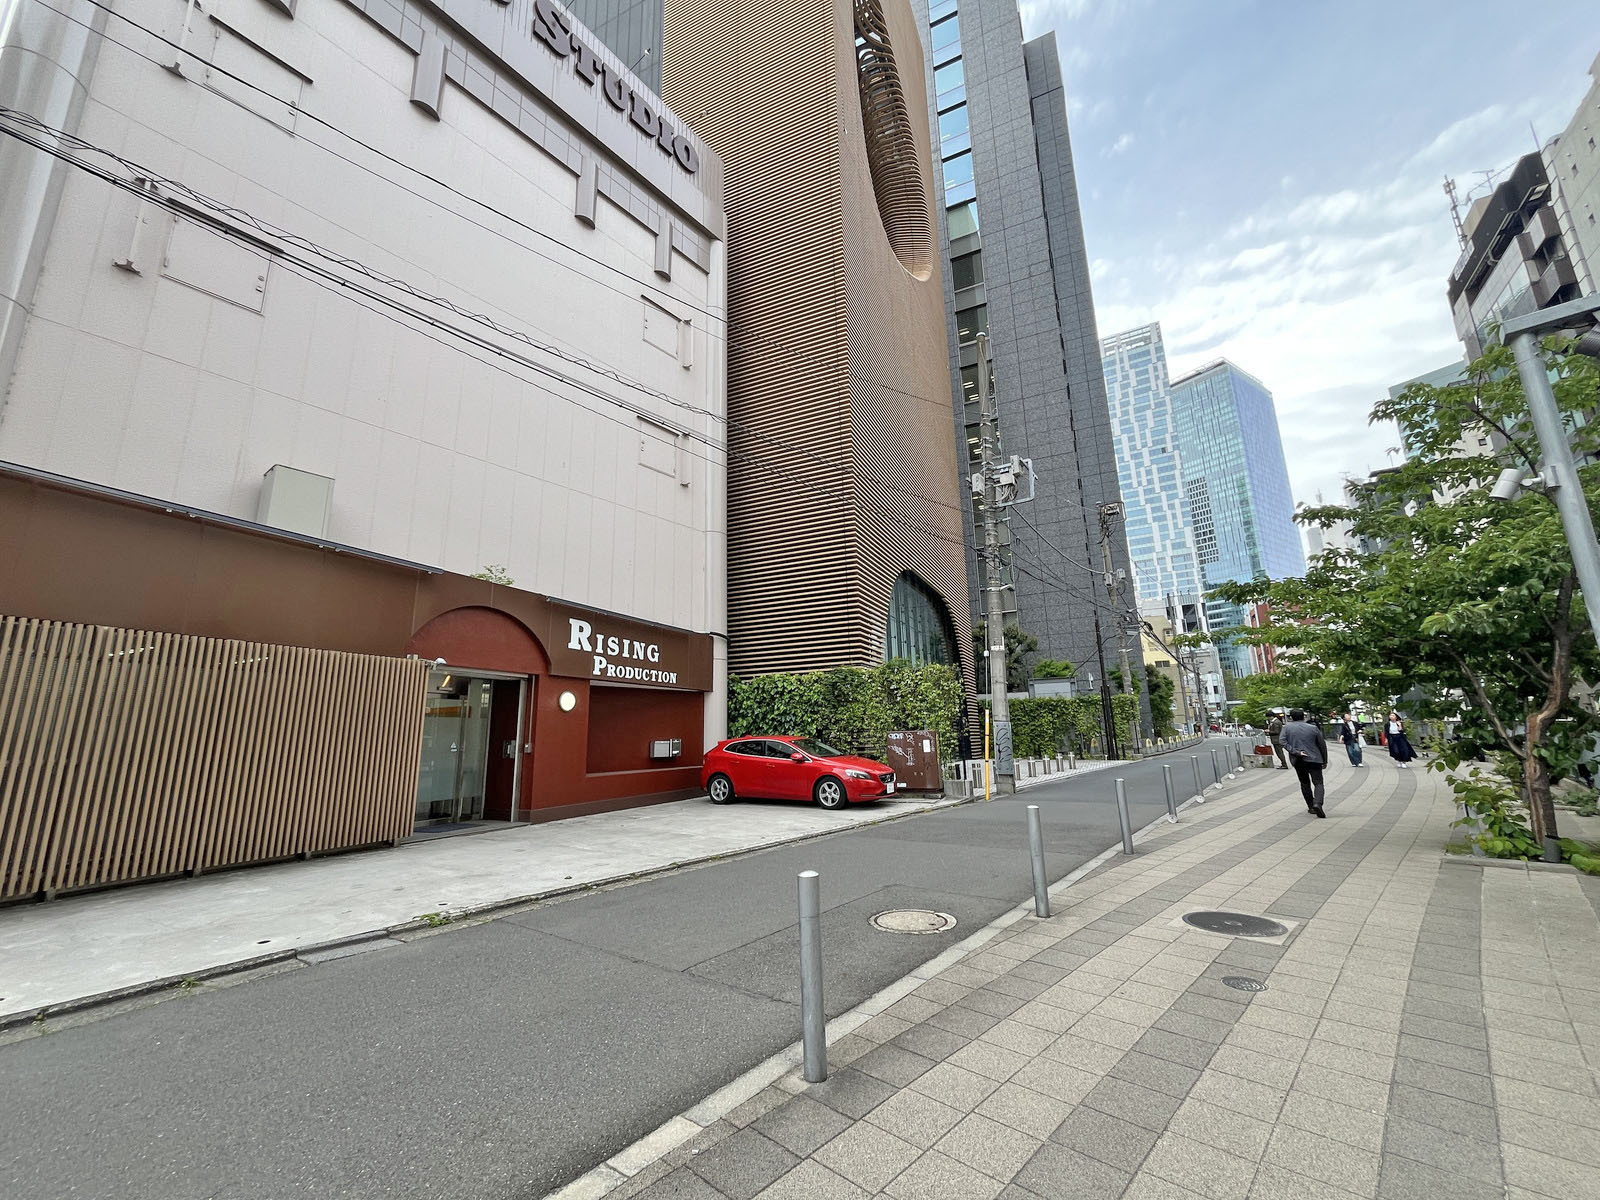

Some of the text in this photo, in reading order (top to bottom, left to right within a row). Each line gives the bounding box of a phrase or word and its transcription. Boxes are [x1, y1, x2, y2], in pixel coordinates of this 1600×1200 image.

[533, 0, 700, 174] STUDIO
[568, 618, 660, 662] RISING
[593, 656, 678, 684] PRODUCTION
